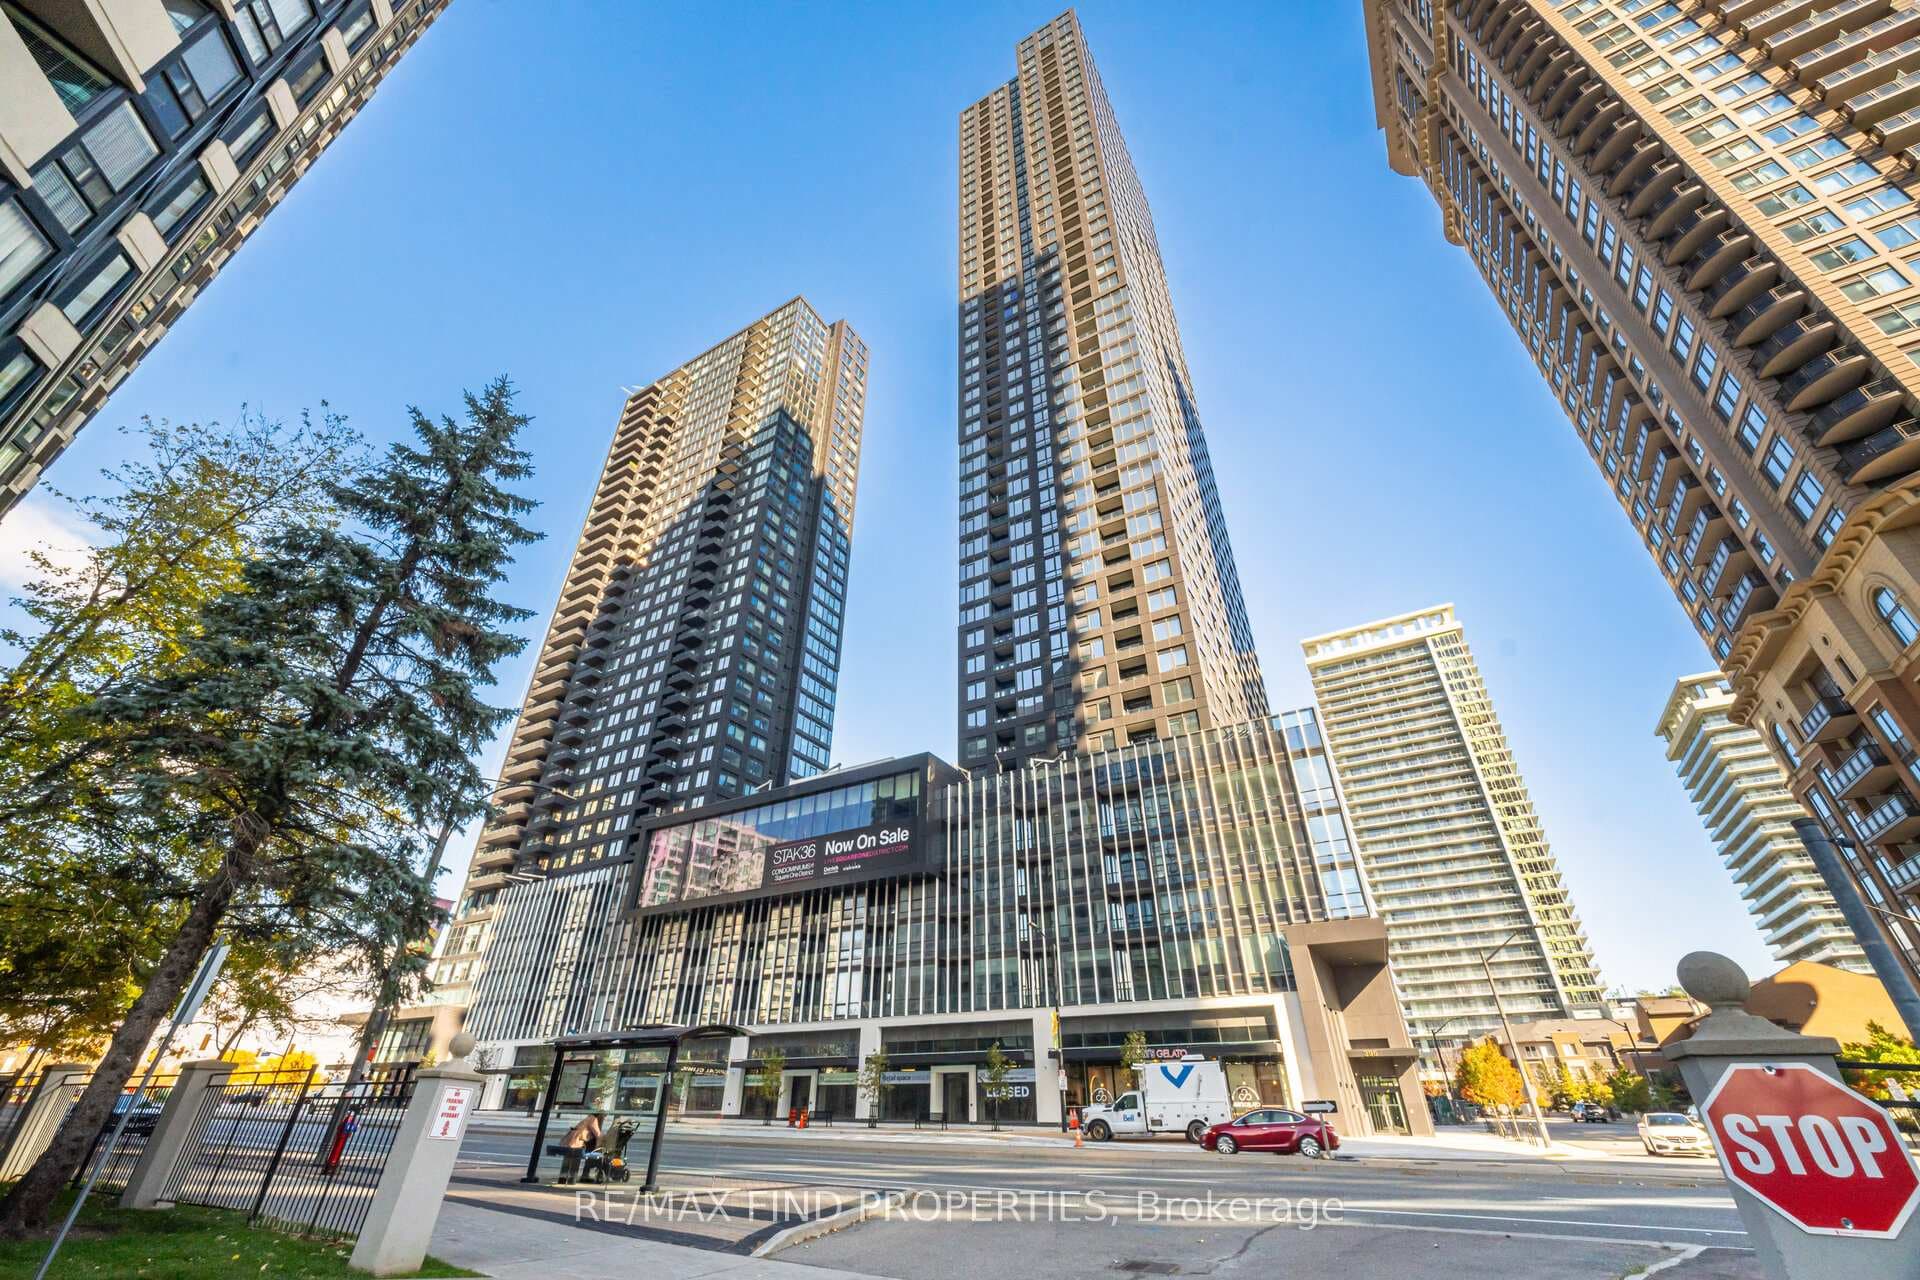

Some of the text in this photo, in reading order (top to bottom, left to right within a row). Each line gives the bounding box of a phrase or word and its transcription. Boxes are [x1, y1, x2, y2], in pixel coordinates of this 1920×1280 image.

[825, 827, 909, 856] Now On Sale
[773, 844, 816, 865] STAK36
[1156, 1049, 1188, 1058] GELATO
[1722, 1113, 1887, 1179] STOP
